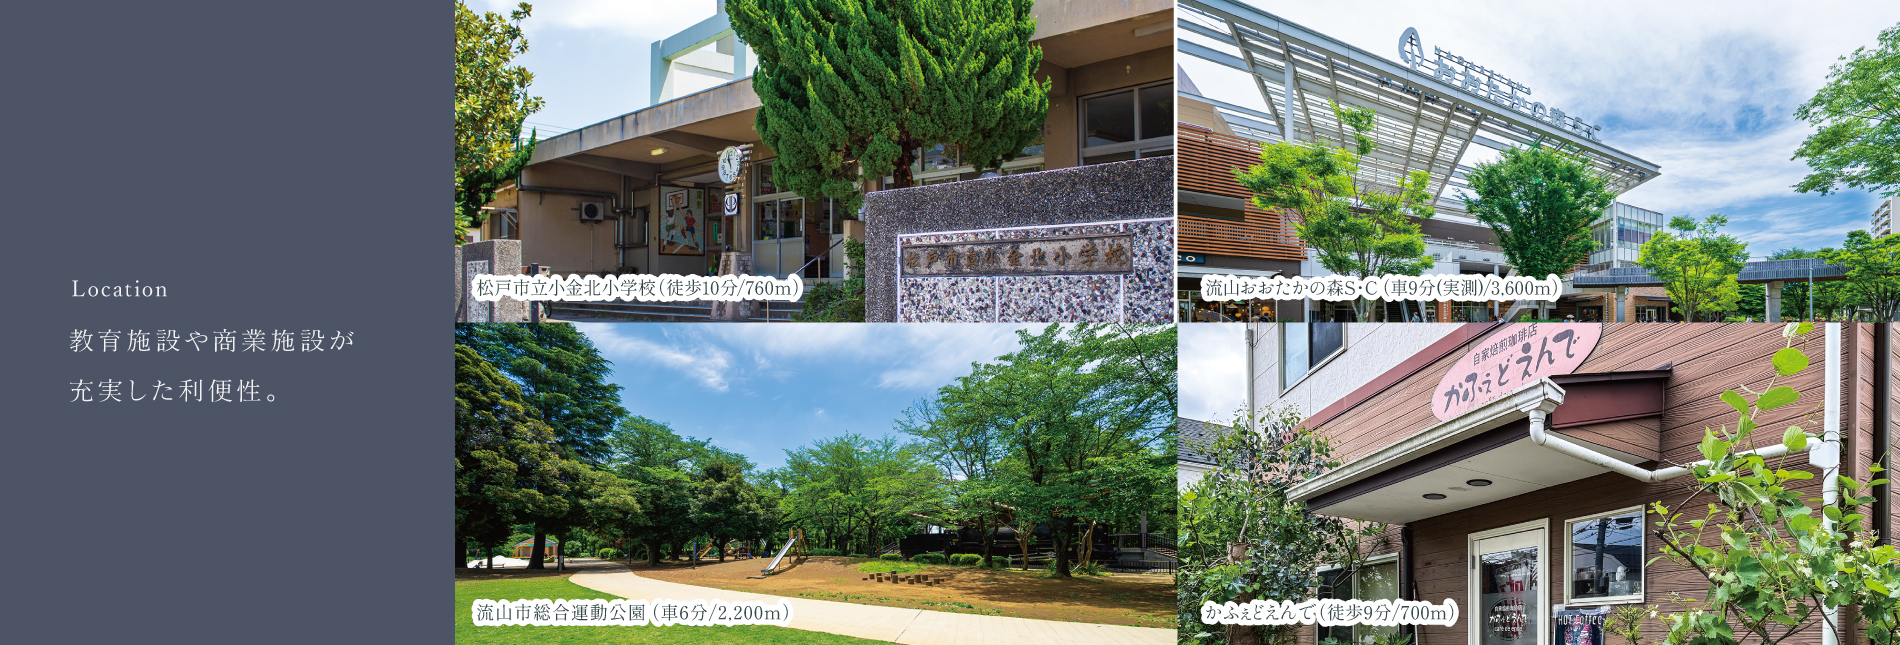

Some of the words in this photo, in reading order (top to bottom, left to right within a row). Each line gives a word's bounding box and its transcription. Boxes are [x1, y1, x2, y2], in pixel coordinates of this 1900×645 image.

[905, 243, 1127, 269] 松戸市立小金北小学校
[1473, 322, 1537, 366] 自家焙煎珈琲店
[1558, 614, 1573, 625] HOT
